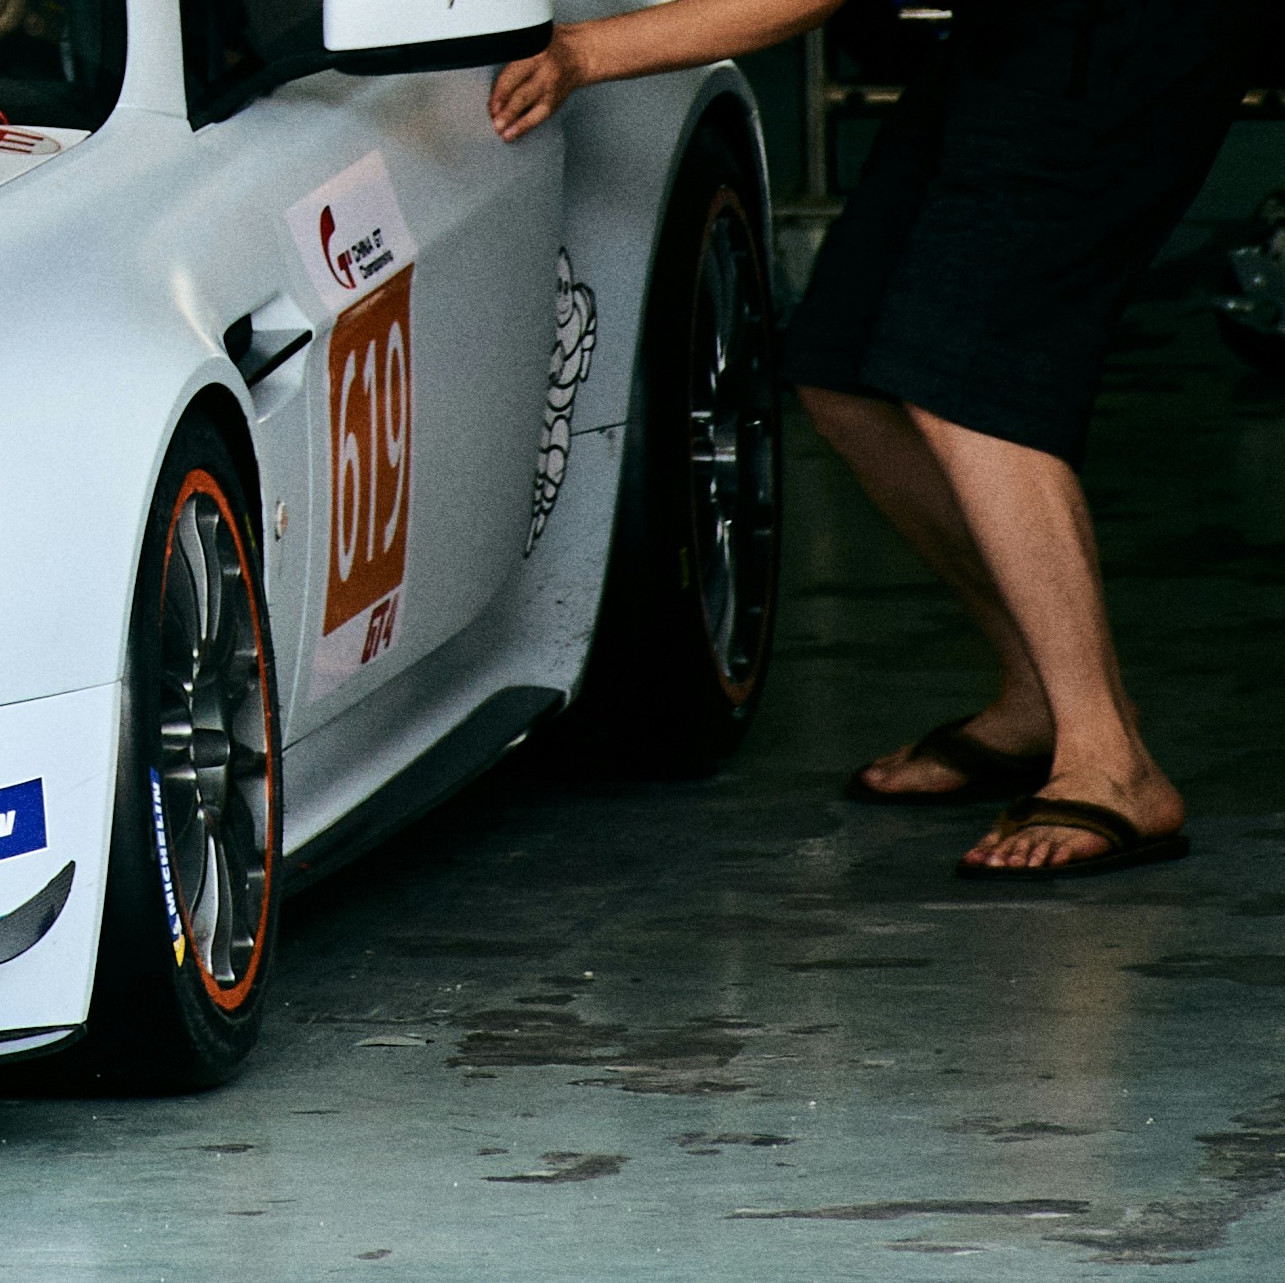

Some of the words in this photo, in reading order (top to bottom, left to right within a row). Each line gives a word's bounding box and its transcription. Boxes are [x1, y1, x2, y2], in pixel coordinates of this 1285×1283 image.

[338, 320, 407, 583] 619
[361, 592, 399, 664] GT4
[152, 781, 177, 916] MICHELIN
